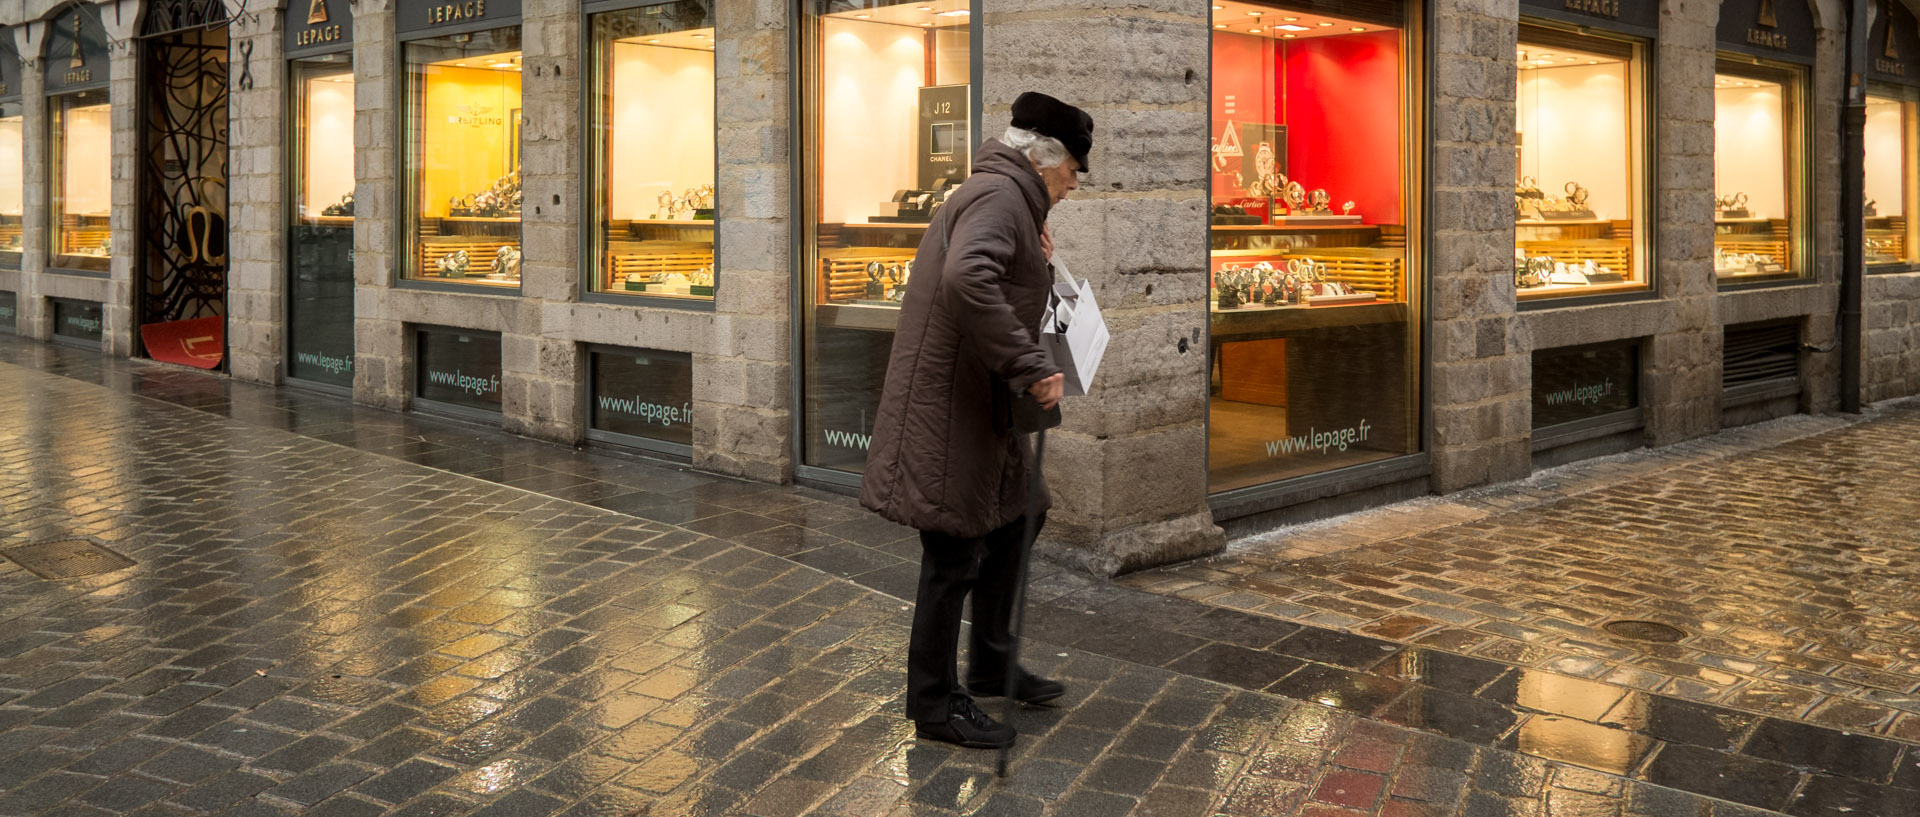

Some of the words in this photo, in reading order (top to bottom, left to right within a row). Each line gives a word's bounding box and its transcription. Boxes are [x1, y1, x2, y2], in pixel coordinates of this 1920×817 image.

[428, 0, 485, 24] LEPAGE
[297, 25, 342, 46] LEPAGE
[1747, 28, 1787, 49] LEPAGE
[930, 155, 953, 163] CHANEL
[1239, 199, 1265, 209] Cartier
[298, 351, 353, 375] www.lepage.fr
[429, 369, 500, 396] www.lepage.fr
[1545, 376, 1614, 406] www.lepage.fr
[598, 395, 693, 426] www.lepage.fr
[1265, 418, 1371, 457] www.lepage.fr
